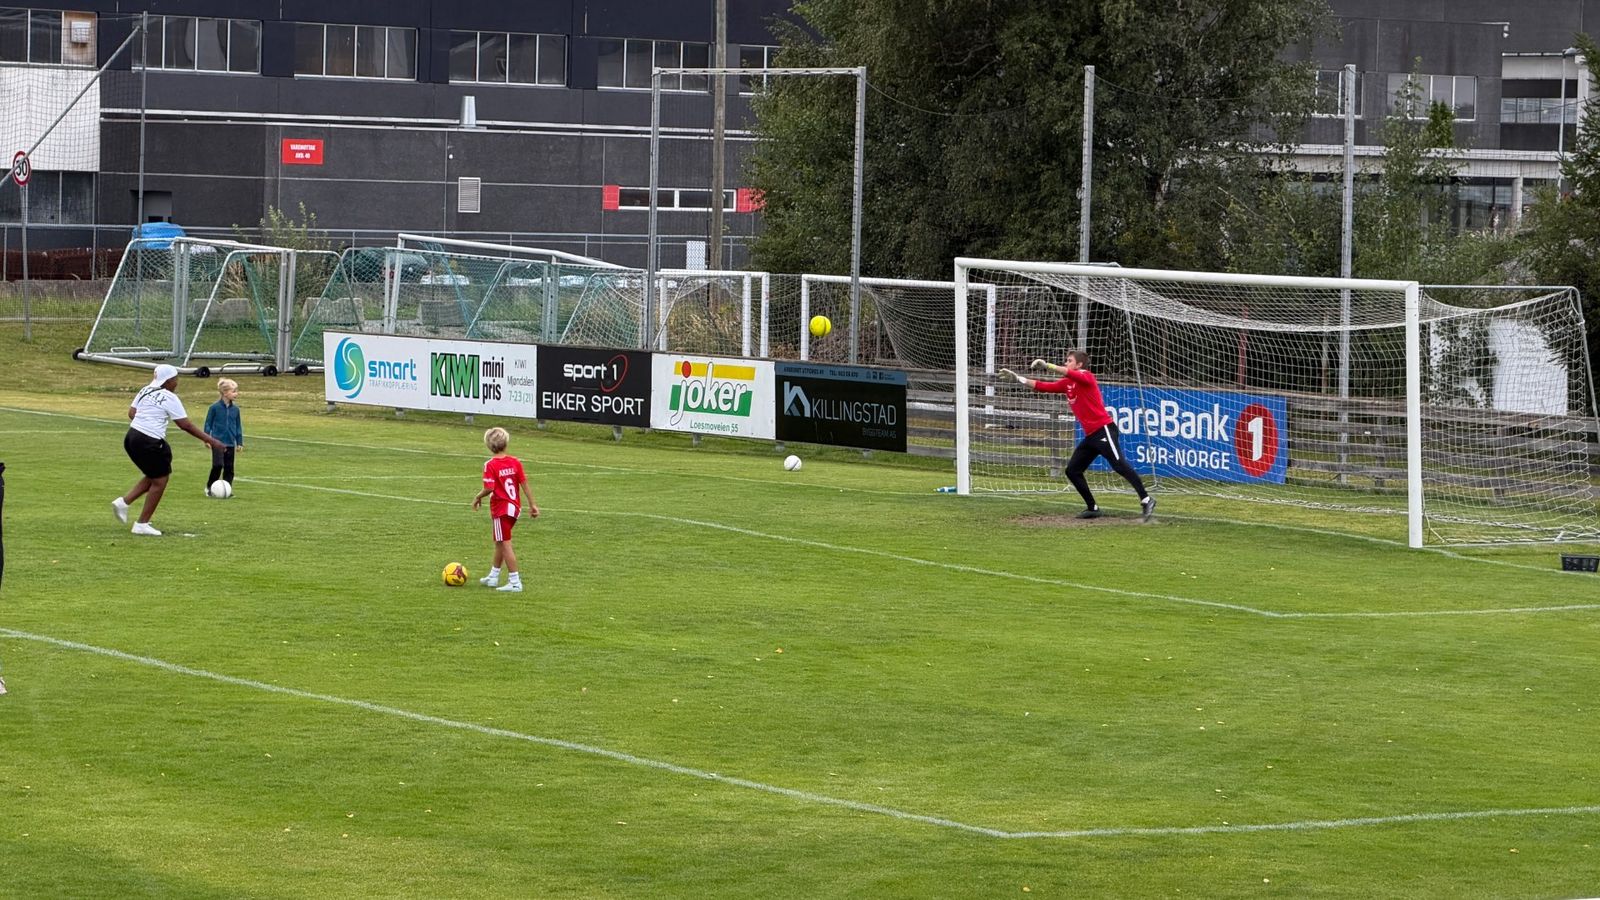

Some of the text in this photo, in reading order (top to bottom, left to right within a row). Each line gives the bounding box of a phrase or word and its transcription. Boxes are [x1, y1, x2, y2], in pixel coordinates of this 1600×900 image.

[368, 359, 417, 381] smart
[482, 356, 504, 378] mini
[514, 359, 527, 369] KIWI
[563, 362, 618, 381] sport 1
[430, 352, 480, 399] KIWI
[507, 375, 534, 387] Mjøndalen
[482, 379, 502, 404] pris
[508, 390, 534, 404] 7-23 (21)
[669, 360, 748, 426] joker
[541, 391, 645, 416] EIKER SPORT
[812, 397, 897, 426] KILLINGSTAD
[690, 419, 739, 433] Loesmoveien 55
[1247, 416, 1264, 462] 1
[1136, 445, 1230, 470] SØR-NORGE
[504, 478, 516, 500] 6
